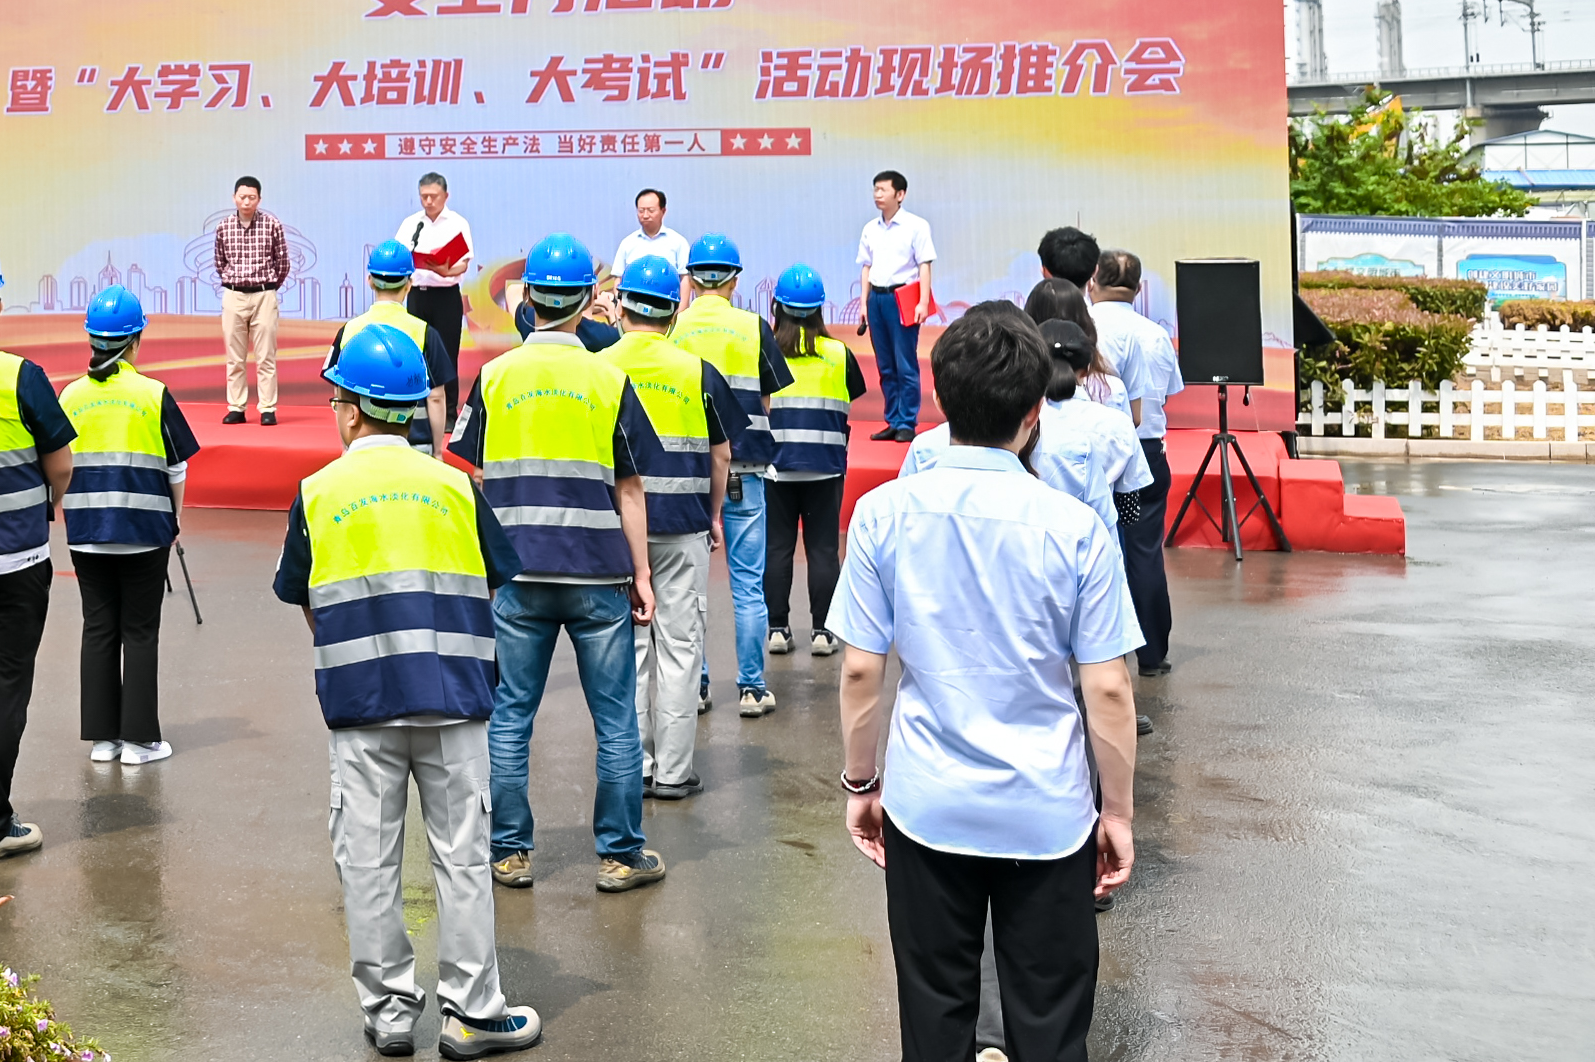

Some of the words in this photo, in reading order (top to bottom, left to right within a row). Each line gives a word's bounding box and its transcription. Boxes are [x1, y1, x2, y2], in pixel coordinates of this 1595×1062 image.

[398, 134, 541, 156] 遵守安全生产法
[557, 132, 706, 154] 当好责任第一人
[332, 492, 449, 524] 青岛百发海水淡化有限公司
